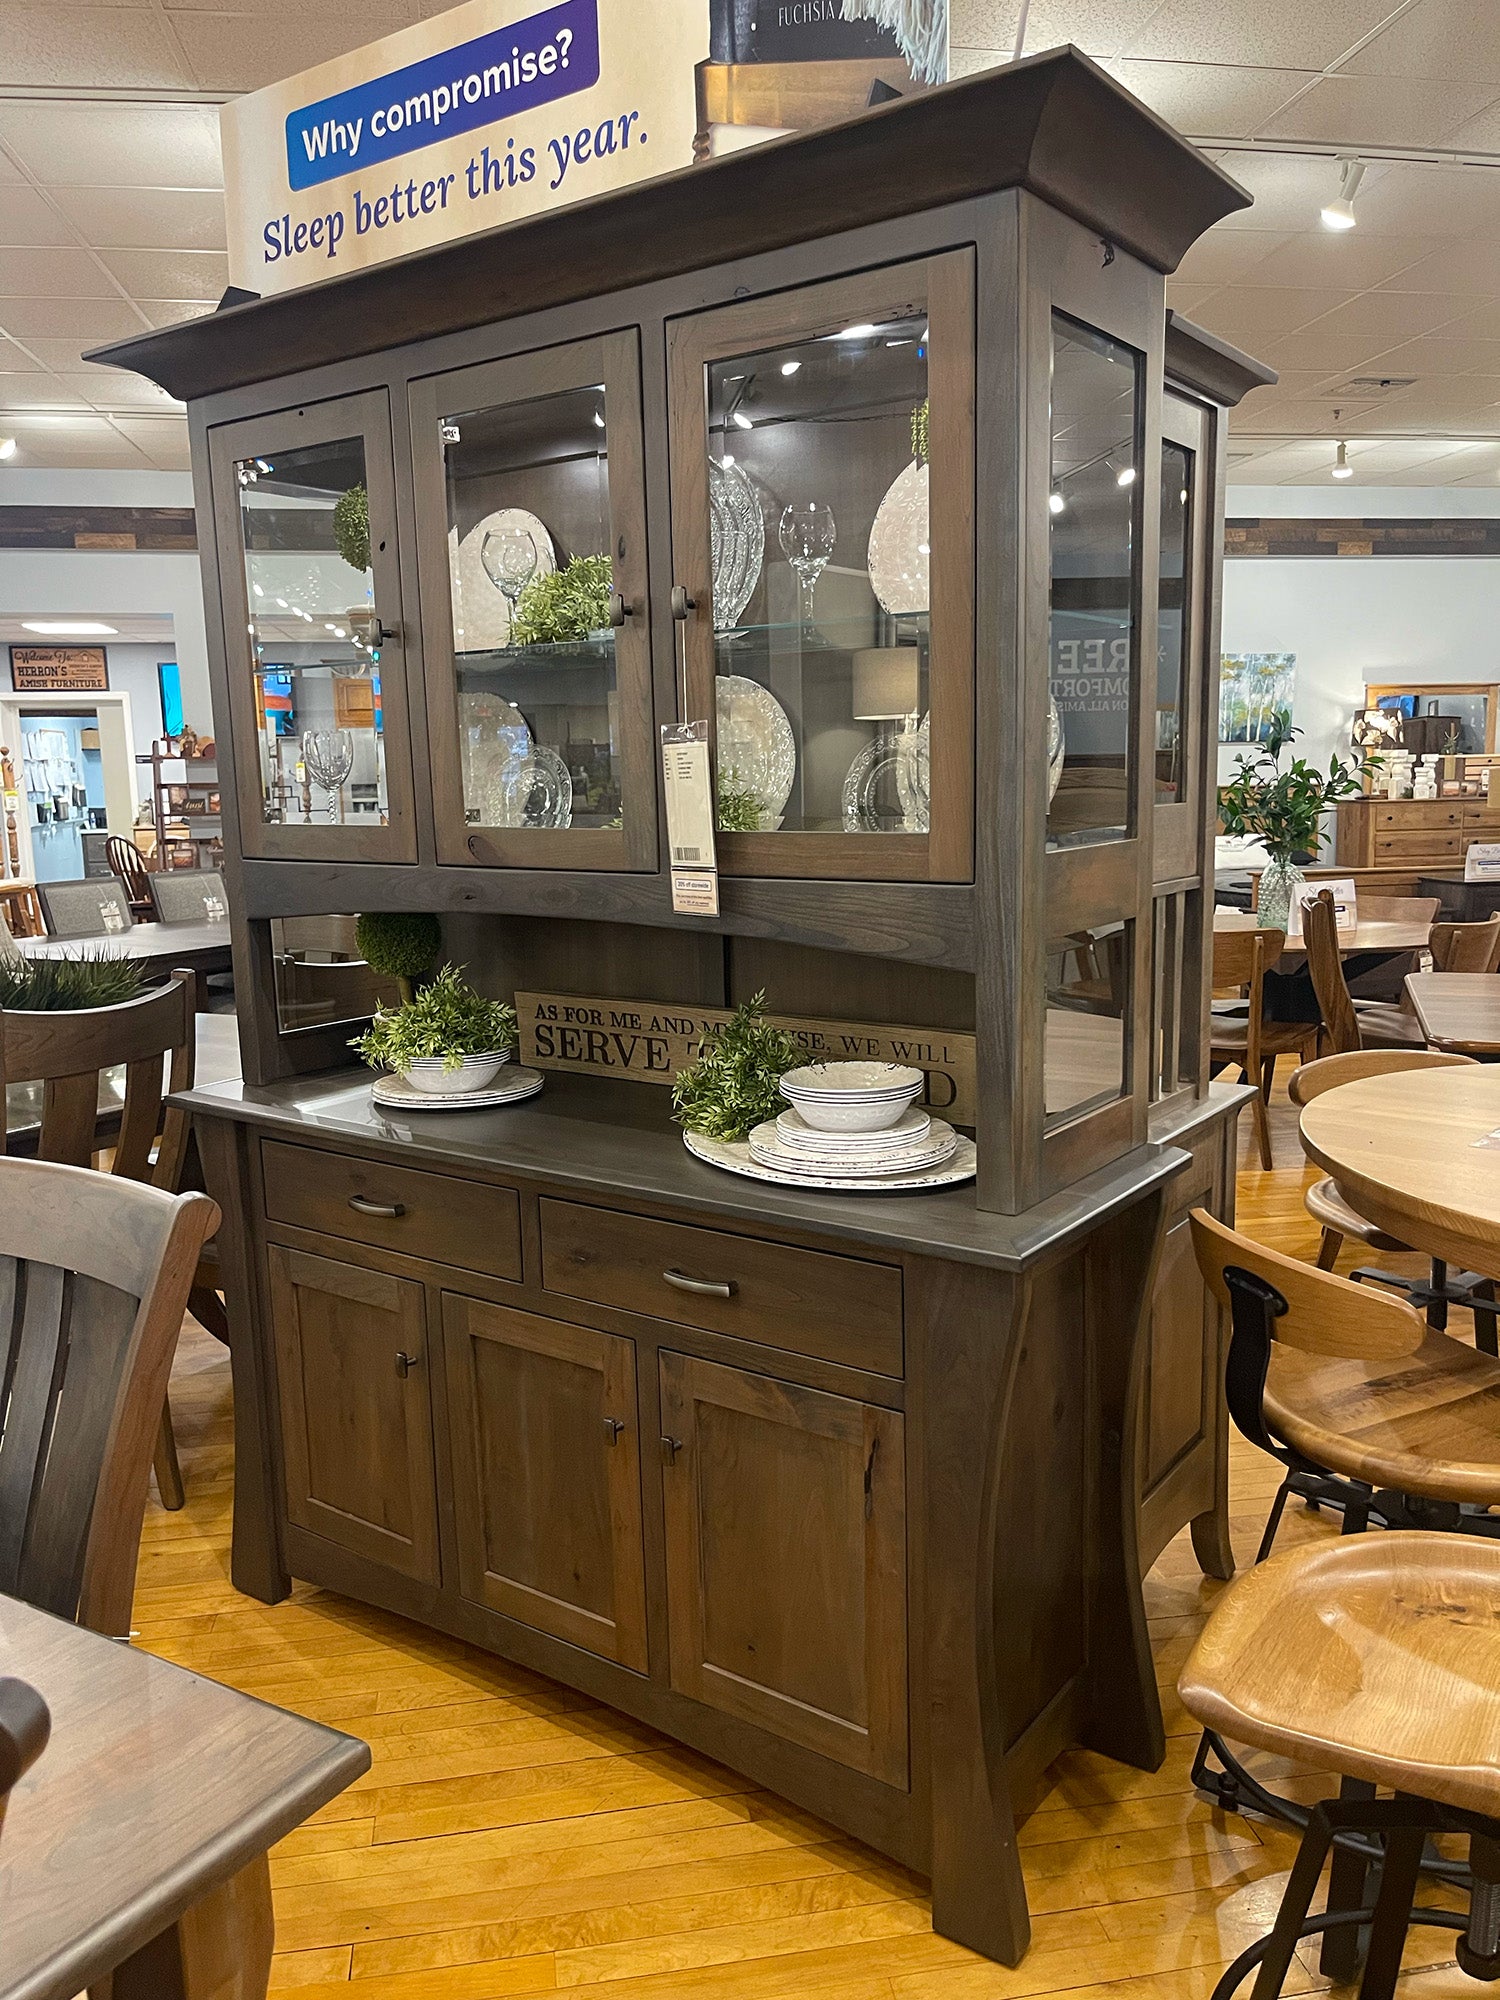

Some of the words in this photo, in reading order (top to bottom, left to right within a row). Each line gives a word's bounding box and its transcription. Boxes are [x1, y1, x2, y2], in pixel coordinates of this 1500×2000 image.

[778, 0, 835, 27] FUCHSIA
[301, 117, 363, 162] Why
[370, 28, 573, 138] compromise?
[263, 214, 344, 263] Sleep
[353, 174, 455, 235] better
[465, 137, 536, 200] this
[547, 110, 648, 190] year.
[17, 665, 68, 677] HERRON'S
[20, 679, 48, 688] AMISH
[50, 679, 103, 688] FURNITURE
[534, 1003, 559, 1021] AS
[563, 1006, 605, 1027] FOR
[608, 1011, 642, 1030] ME
[649, 1016, 695, 1035] AND
[839, 1035, 881, 1057] WE
[890, 1040, 956, 1065] WILL
[534, 1023, 671, 1073] SERVE
